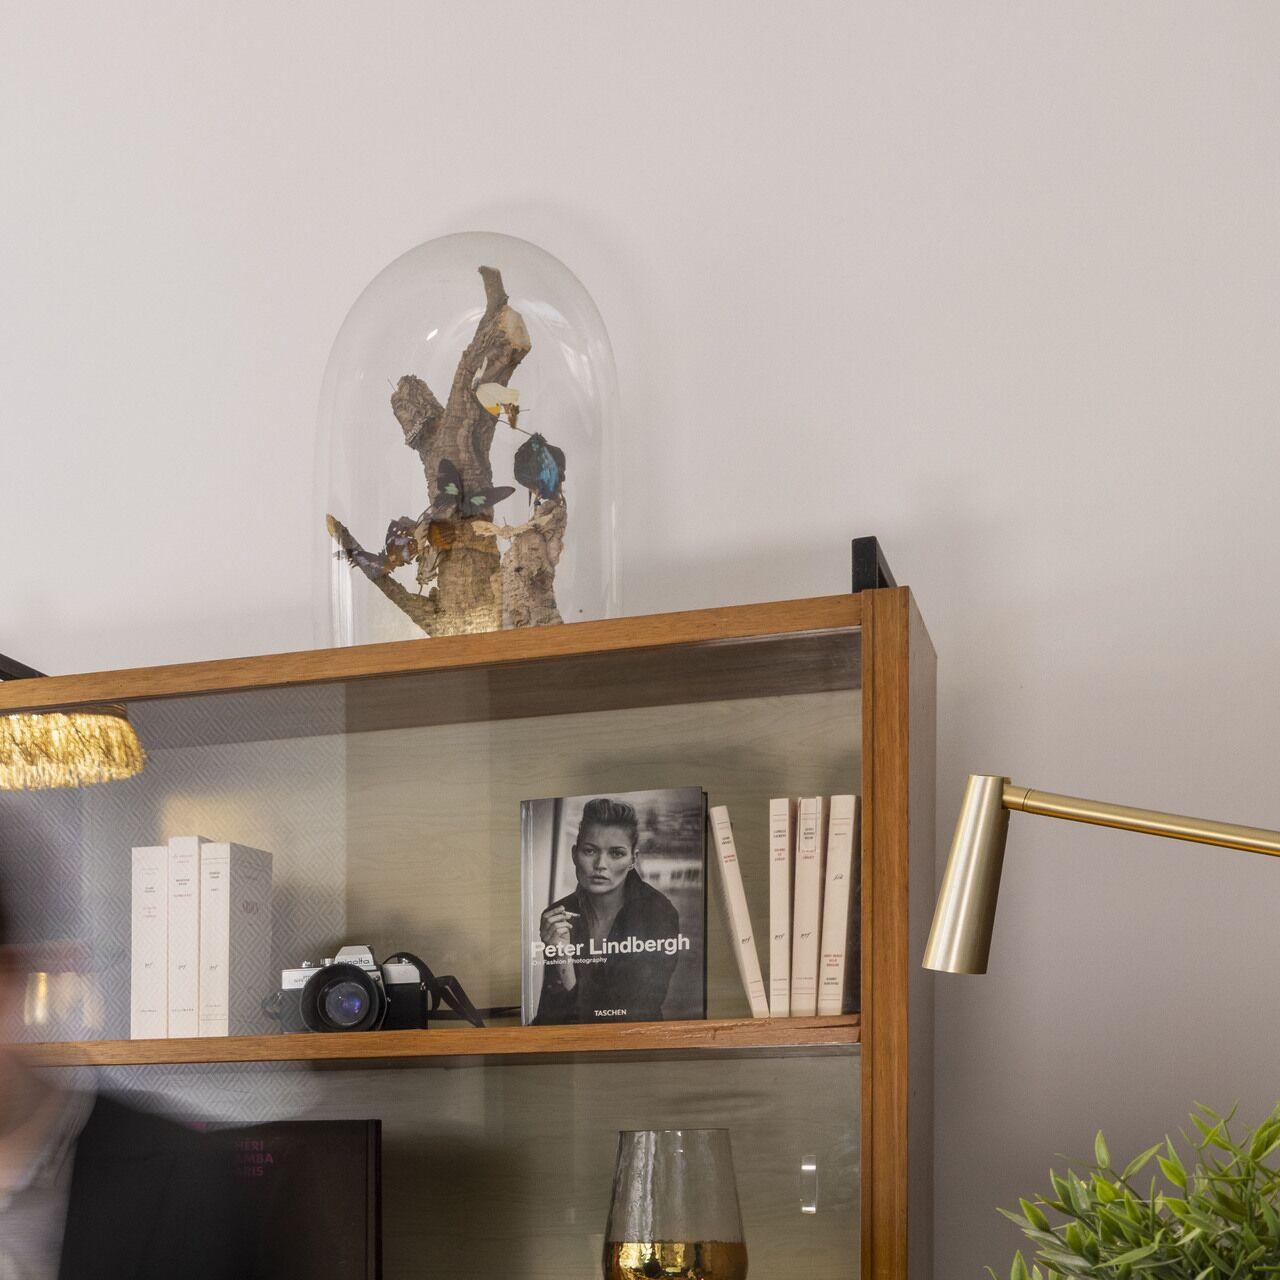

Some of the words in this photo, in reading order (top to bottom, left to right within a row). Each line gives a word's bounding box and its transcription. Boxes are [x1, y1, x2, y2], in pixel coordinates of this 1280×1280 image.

[531, 941, 584, 958] Peter
[589, 934, 690, 955] Lindbergh
[567, 956, 607, 965] Photography
[594, 1009, 627, 1017] TASCHEN
